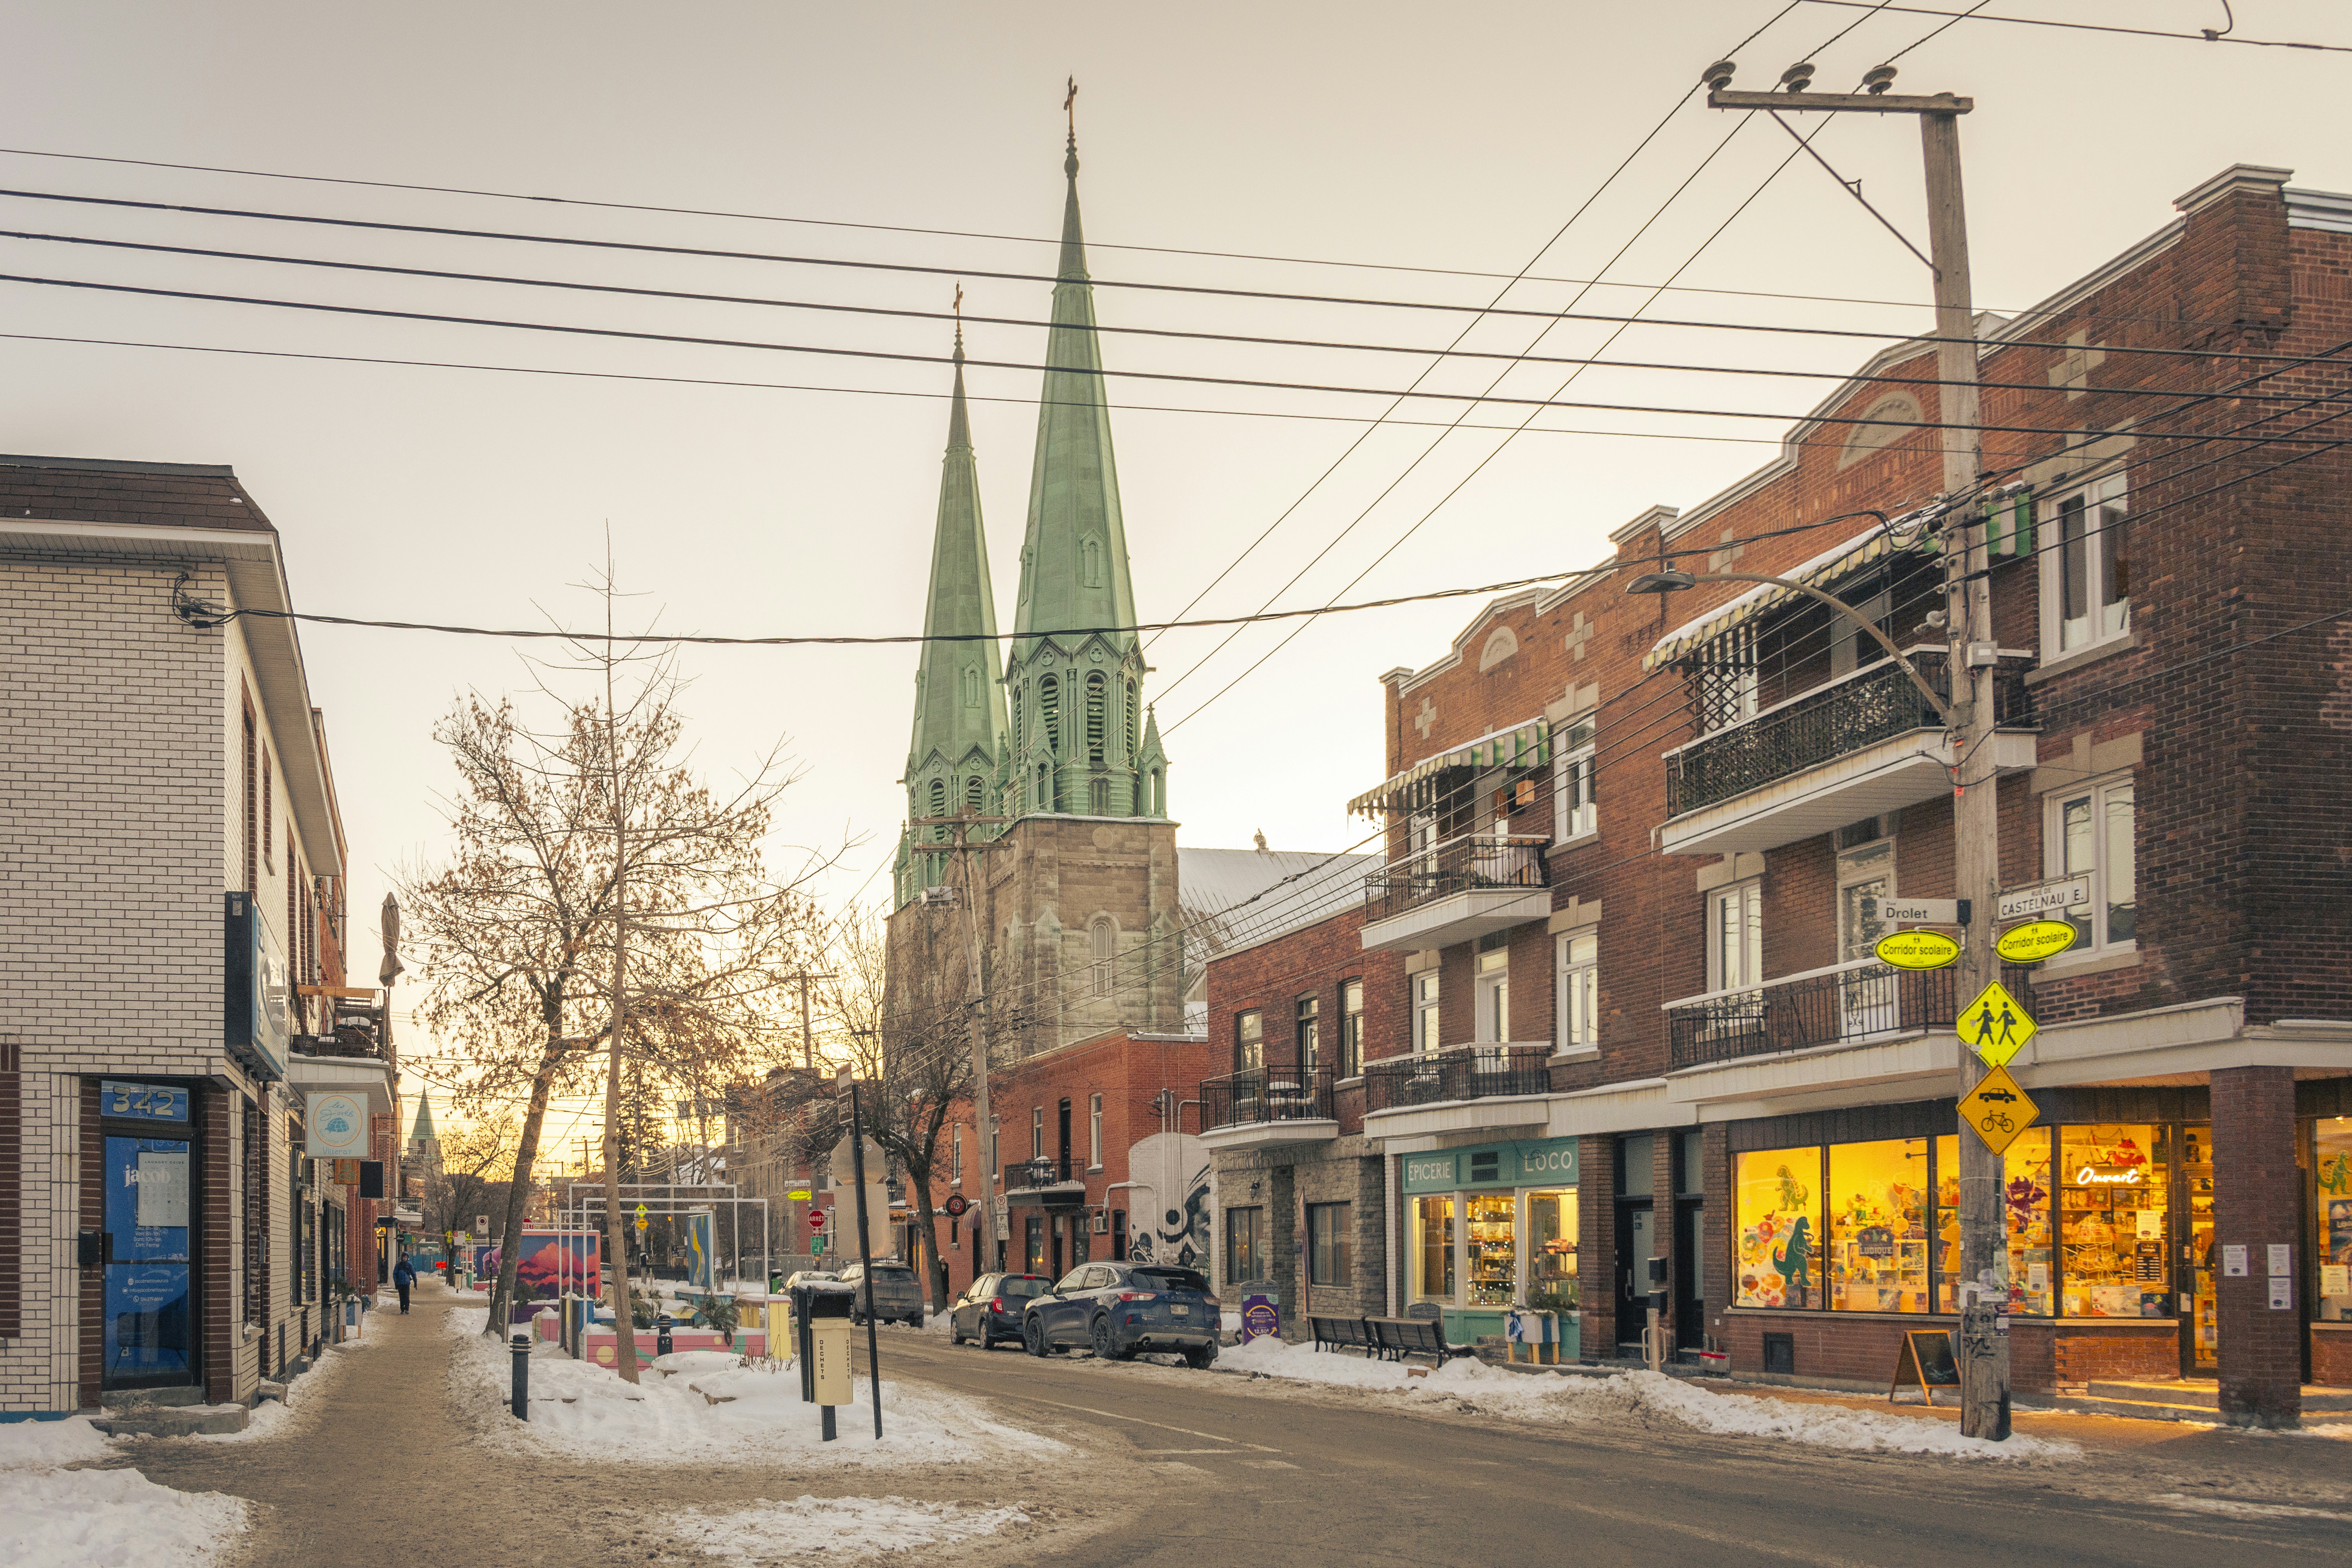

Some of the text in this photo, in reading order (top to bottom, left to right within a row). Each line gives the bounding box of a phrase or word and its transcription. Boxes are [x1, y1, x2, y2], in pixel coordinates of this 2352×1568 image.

[2002, 889, 2084, 916] CASTELNAU E.
[1886, 907, 1927, 918] Drolet
[1883, 944, 1952, 955] Corridor scolaire
[2002, 931, 2068, 950] Corridor scolaire
[113, 1085, 174, 1116] 342
[323, 1147, 352, 1155] Villeray
[124, 1164, 171, 1187] jacob
[1408, 1151, 1572, 1181] ÉPICERIE LOCO
[2076, 1166, 2140, 1185] Ouvert
